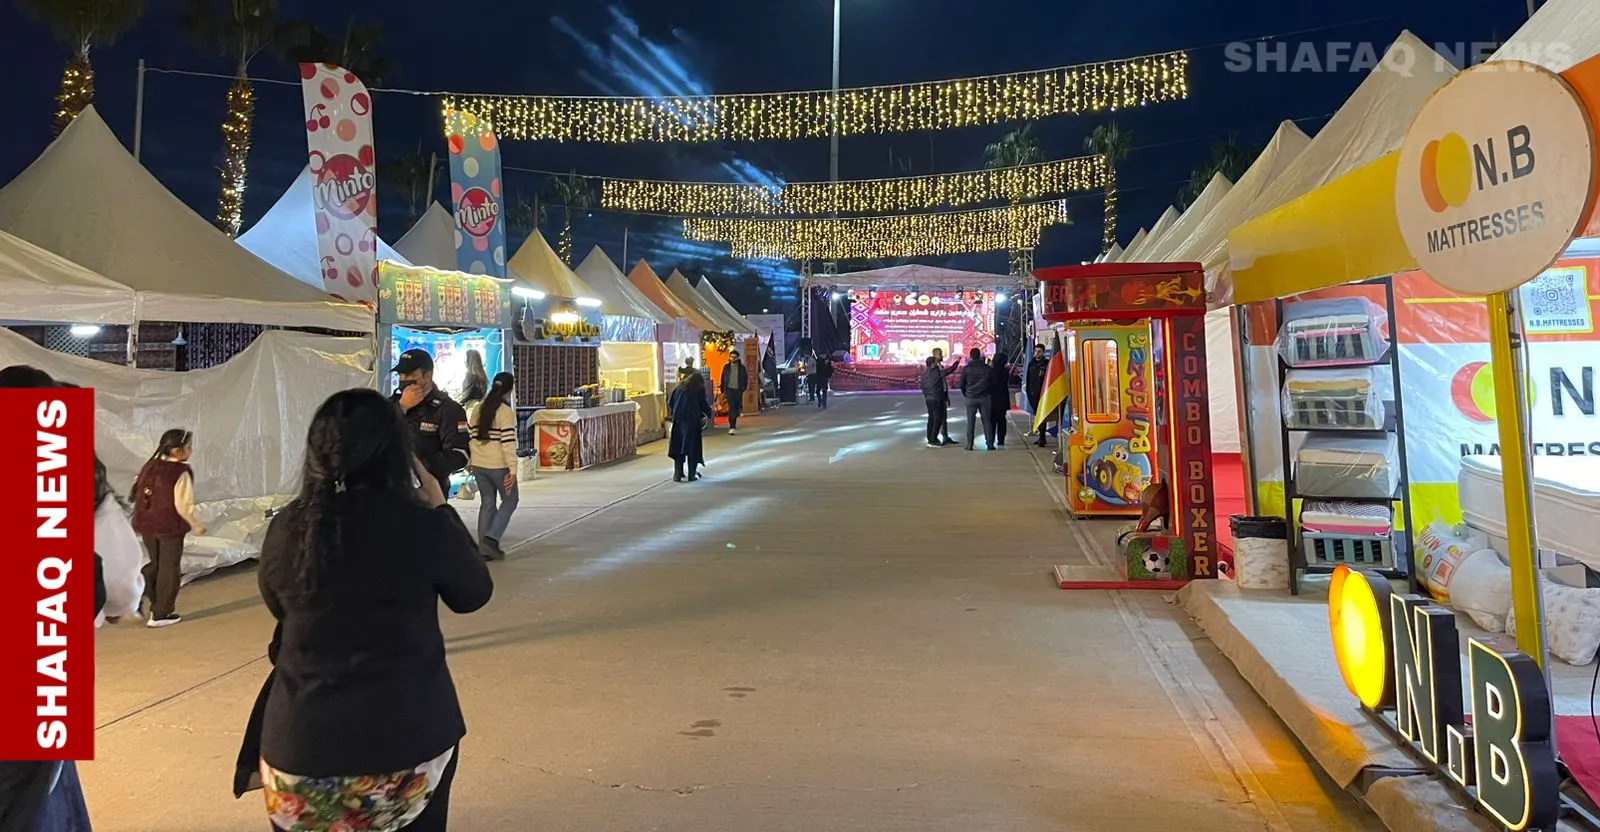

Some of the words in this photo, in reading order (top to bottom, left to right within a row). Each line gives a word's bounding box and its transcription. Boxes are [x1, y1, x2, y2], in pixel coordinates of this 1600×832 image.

[313, 165, 374, 210] Minto
[1472, 124, 1536, 191] N.B
[454, 197, 500, 230] Minto
[1427, 200, 1546, 254] MATTRESSES
[1182, 332, 1202, 446] COMBO
[1187, 459, 1210, 577] BOXER
[1390, 592, 1530, 831] N.B
